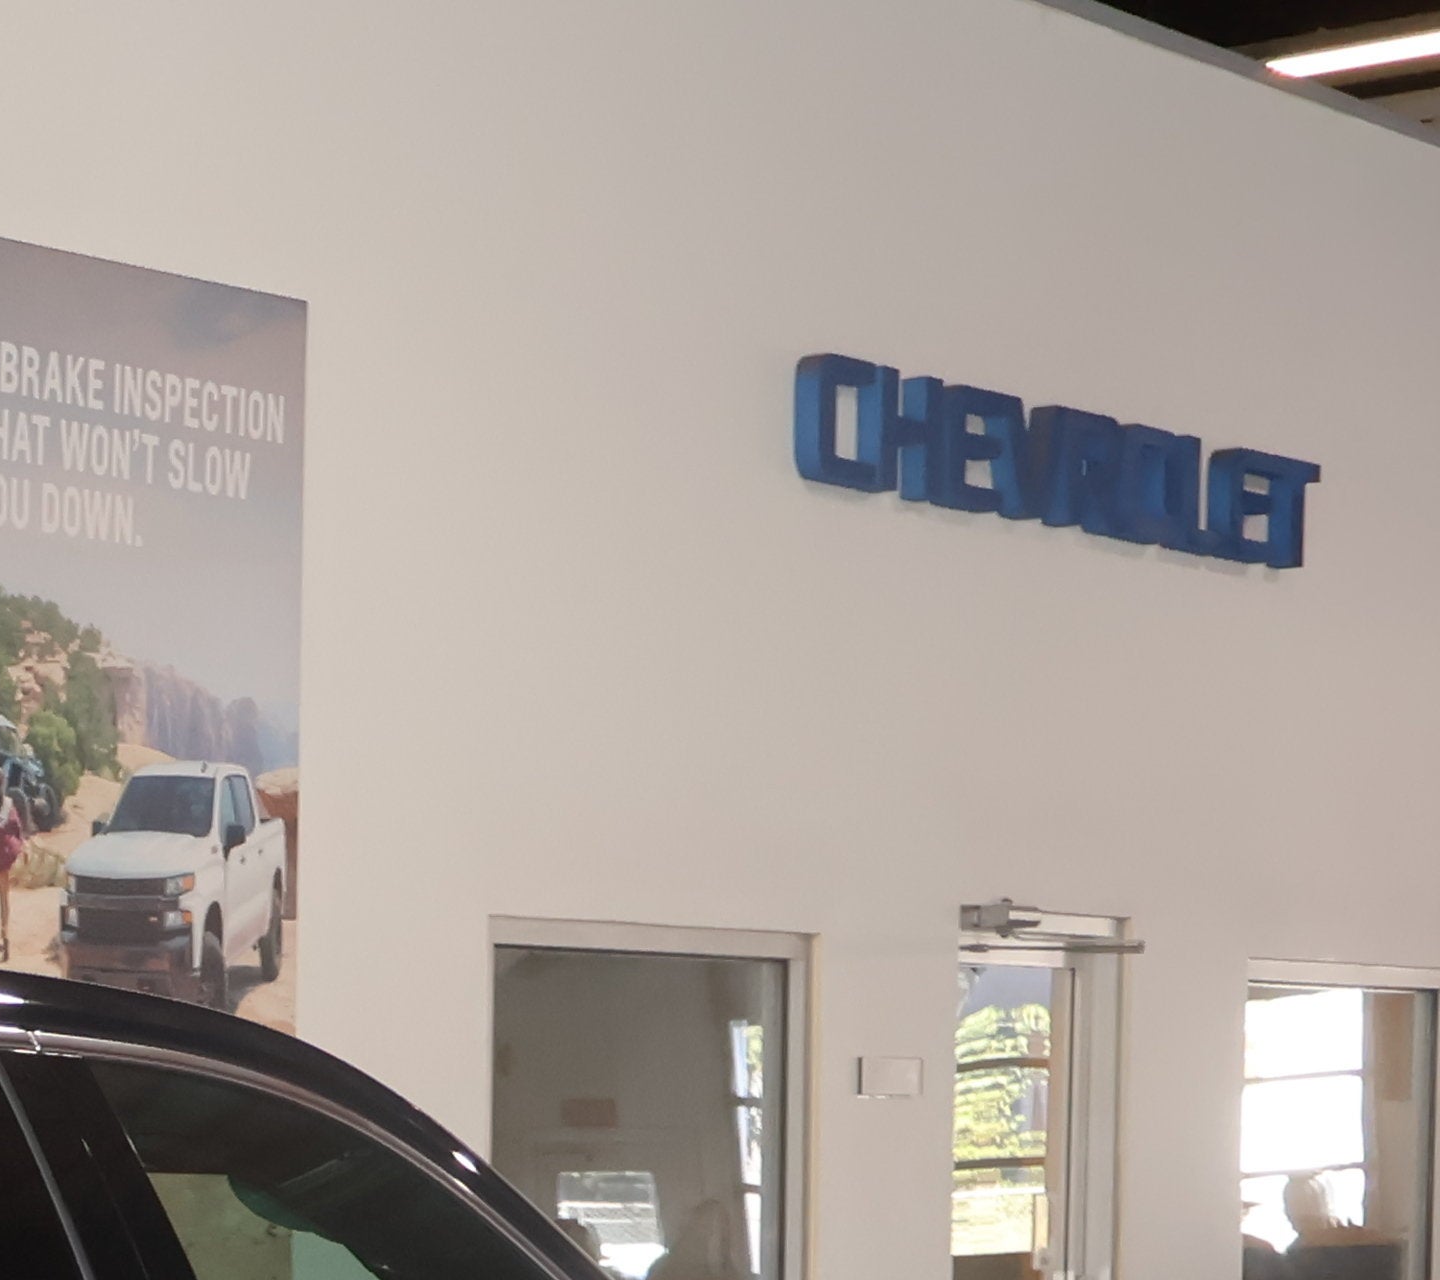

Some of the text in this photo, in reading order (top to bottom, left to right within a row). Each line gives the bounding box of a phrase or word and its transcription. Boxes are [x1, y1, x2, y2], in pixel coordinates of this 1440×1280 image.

[0, 340, 106, 410] BRAKE
[113, 363, 286, 444] INSPECTION
[60, 418, 161, 486] WON'T
[167, 438, 252, 500] SLOW
[794, 353, 1321, 569] CHEVROLET
[41, 482, 144, 548] DOWN.
